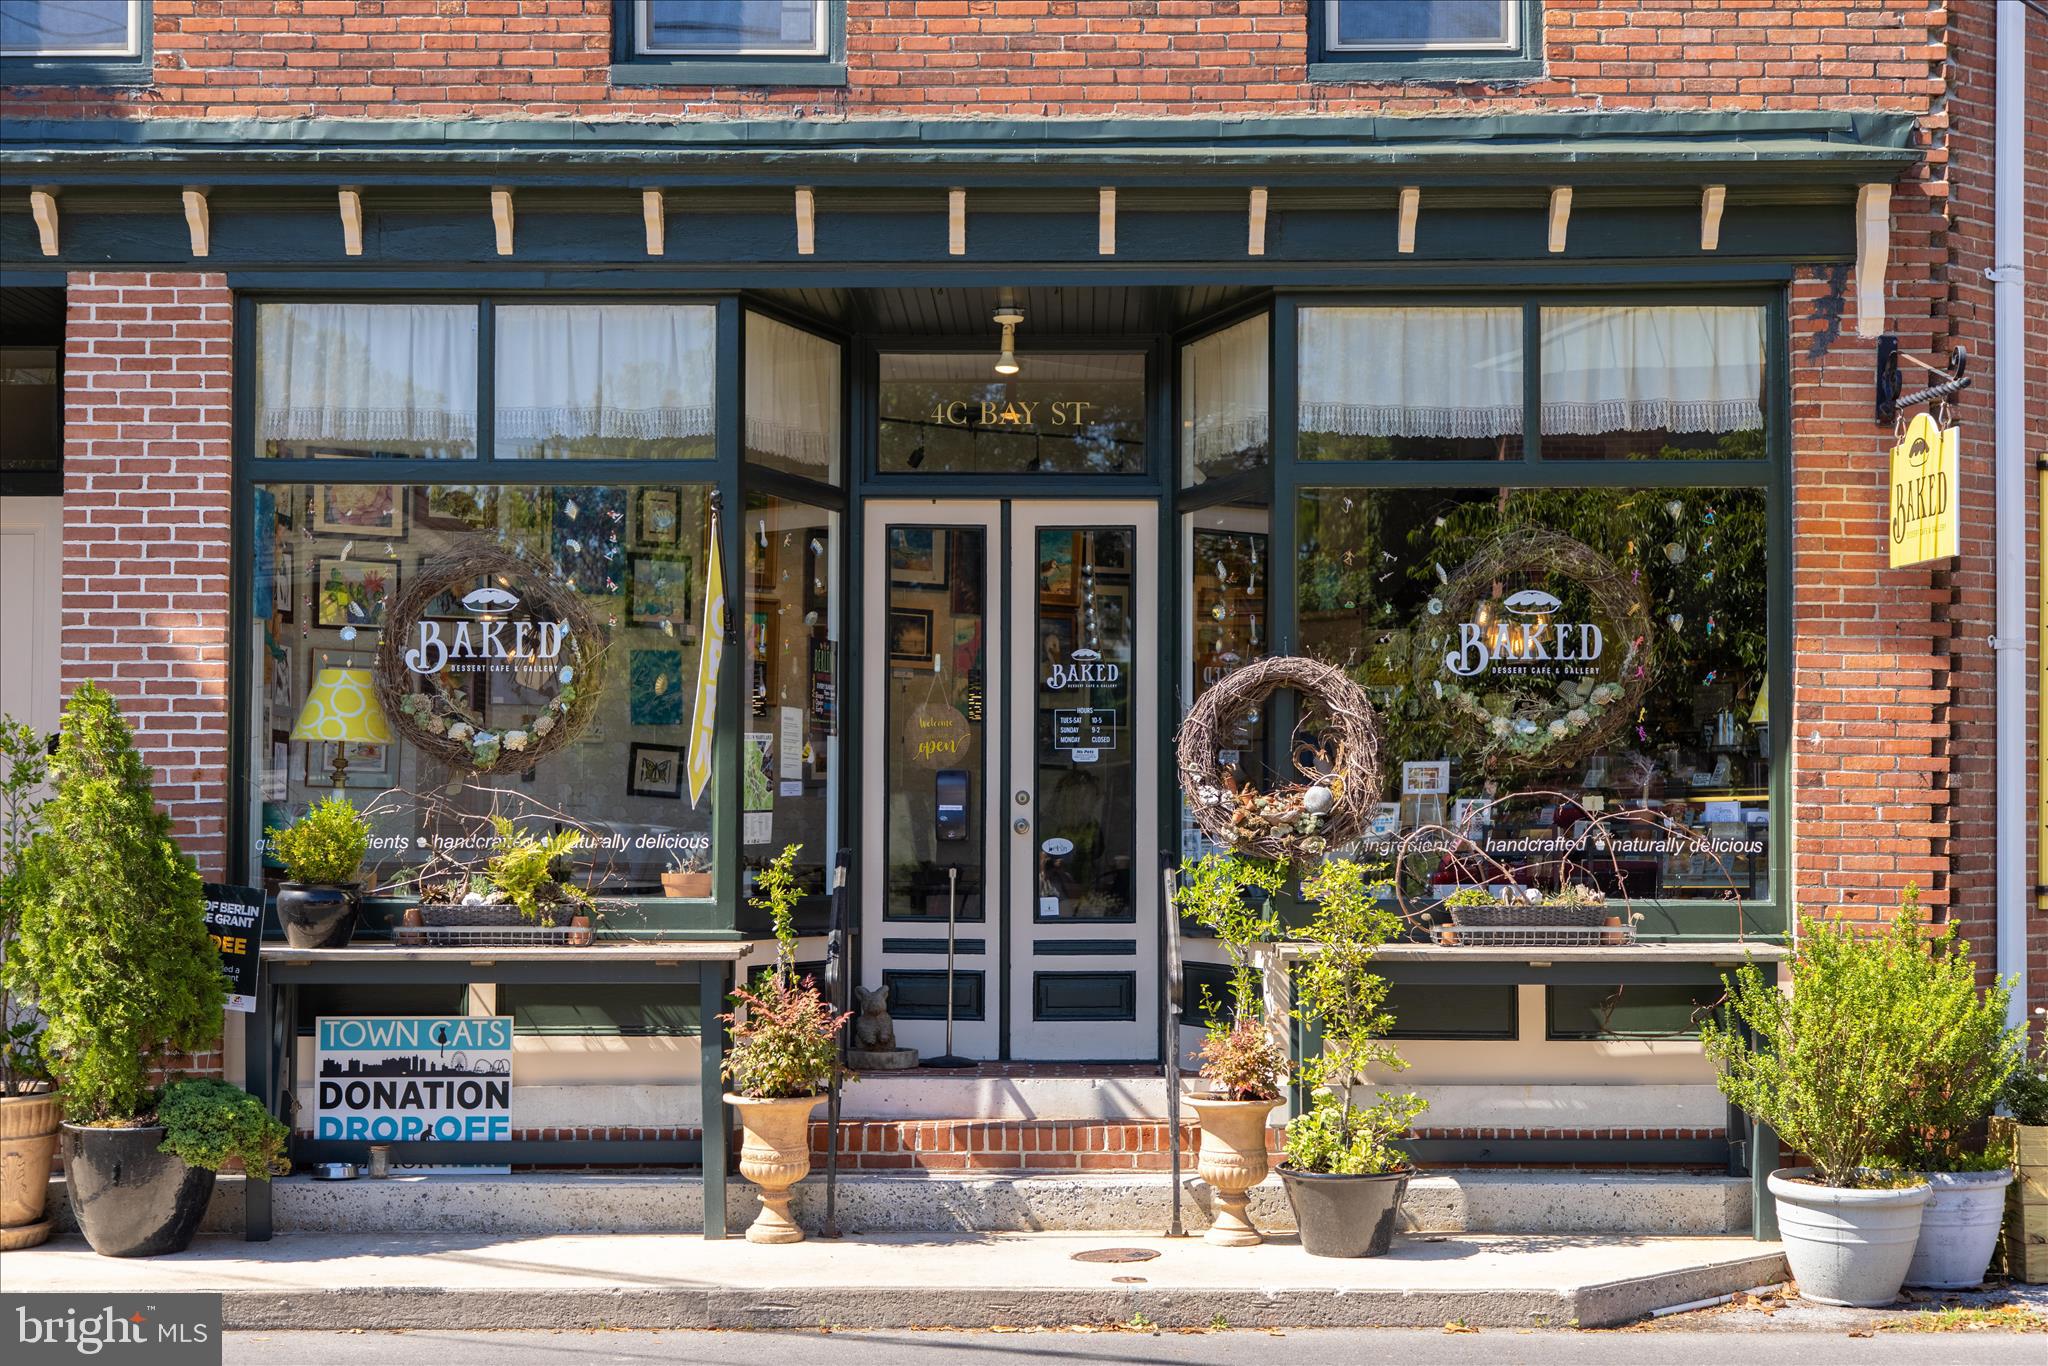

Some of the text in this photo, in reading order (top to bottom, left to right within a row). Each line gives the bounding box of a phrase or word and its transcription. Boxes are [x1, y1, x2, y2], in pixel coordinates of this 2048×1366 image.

[930, 401, 1095, 425] 4C BAY ST.
[1893, 471, 1947, 544] BAKED
[405, 621, 562, 674] BAKED
[1446, 623, 1603, 676] BAKED
[451, 664, 486, 672] DESSERT
[490, 664, 510, 672] CAFE
[523, 664, 558, 672] GALLERY
[1047, 664, 1119, 689] BAKED
[1492, 666, 1527, 674] DESSERT
[1531, 666, 1550, 674] CAFE
[1564, 666, 1600, 674] GALLERY
[635, 833, 709, 849] delicious
[1485, 837, 1588, 852] handcrafted
[1612, 837, 1685, 855] naturally
[1690, 837, 1763, 853] delicious
[215, 914, 255, 928] GRANT
[220, 902, 260, 917] BERLIN
[324, 1021, 505, 1047] TOWN CATS
[320, 1080, 509, 1110] DONATION
[319, 1115, 509, 1141] DROP OFF
